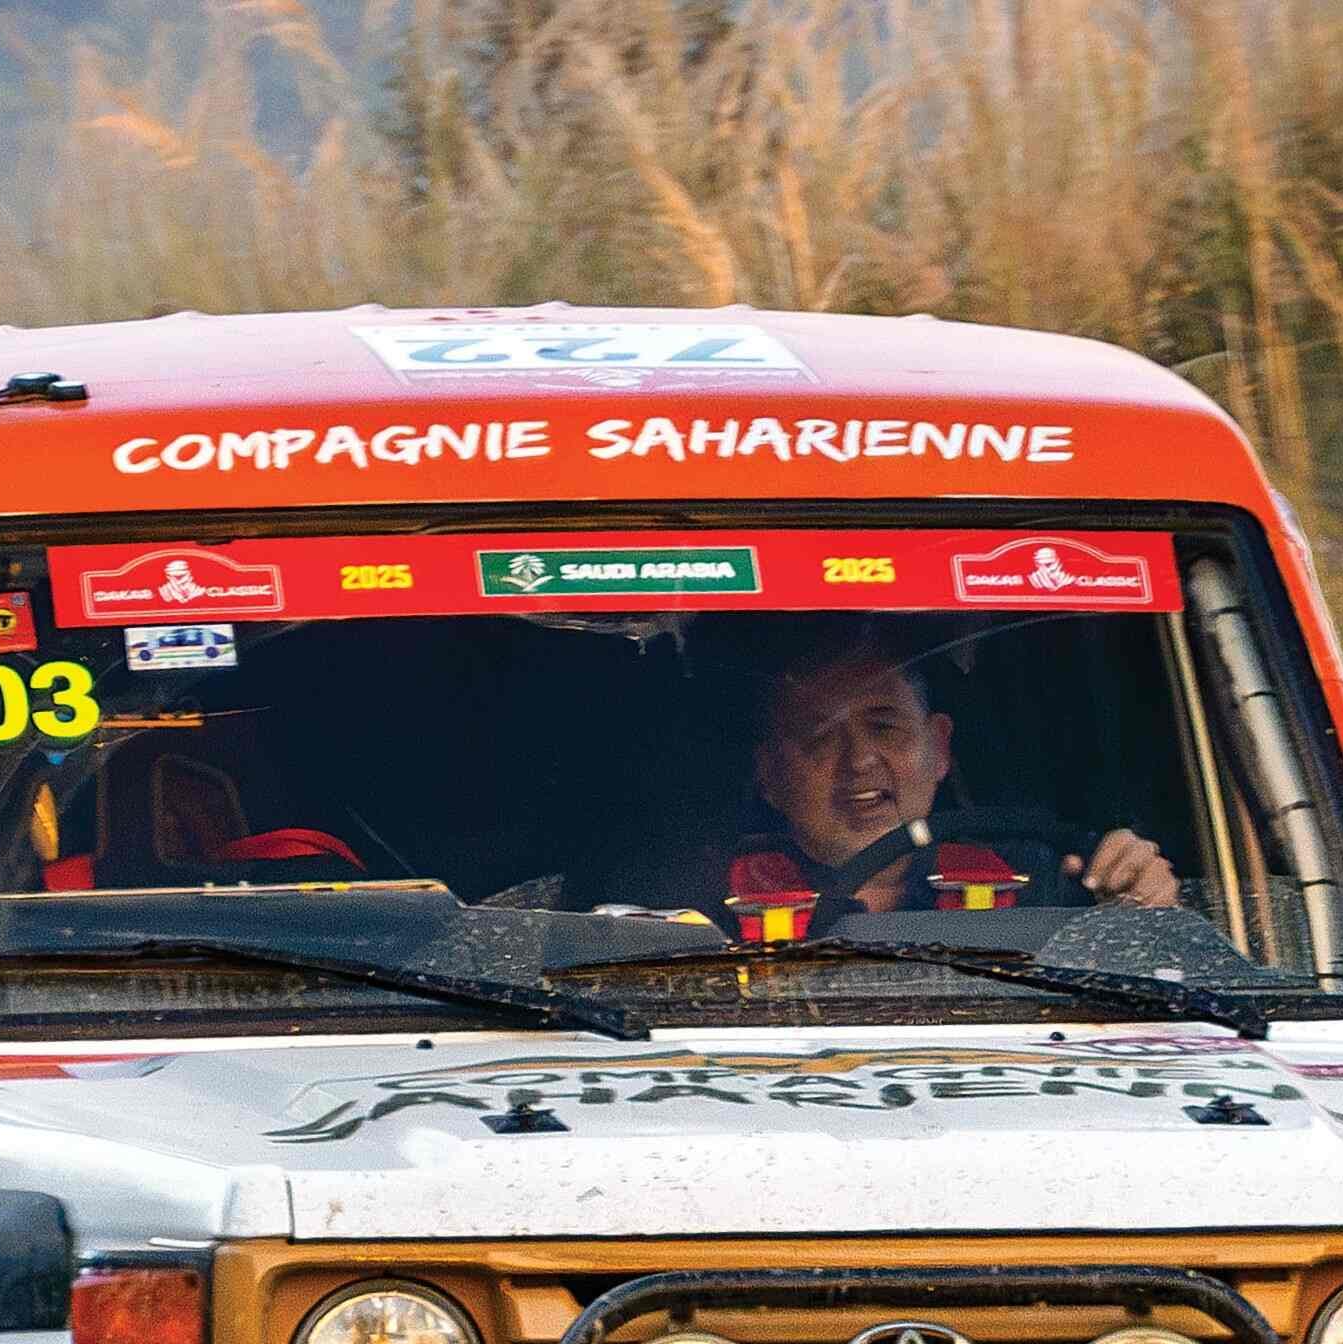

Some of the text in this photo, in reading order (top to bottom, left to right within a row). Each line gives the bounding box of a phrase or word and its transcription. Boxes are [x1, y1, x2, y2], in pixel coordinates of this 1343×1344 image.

[113, 417, 1075, 475] COMPAGNIE SAHARIENNE
[339, 564, 413, 590] 2025
[560, 562, 737, 580] SAUDI ARABIA
[821, 557, 897, 584] 2025
[374, 1065, 1222, 1091] COMPAGNIE
